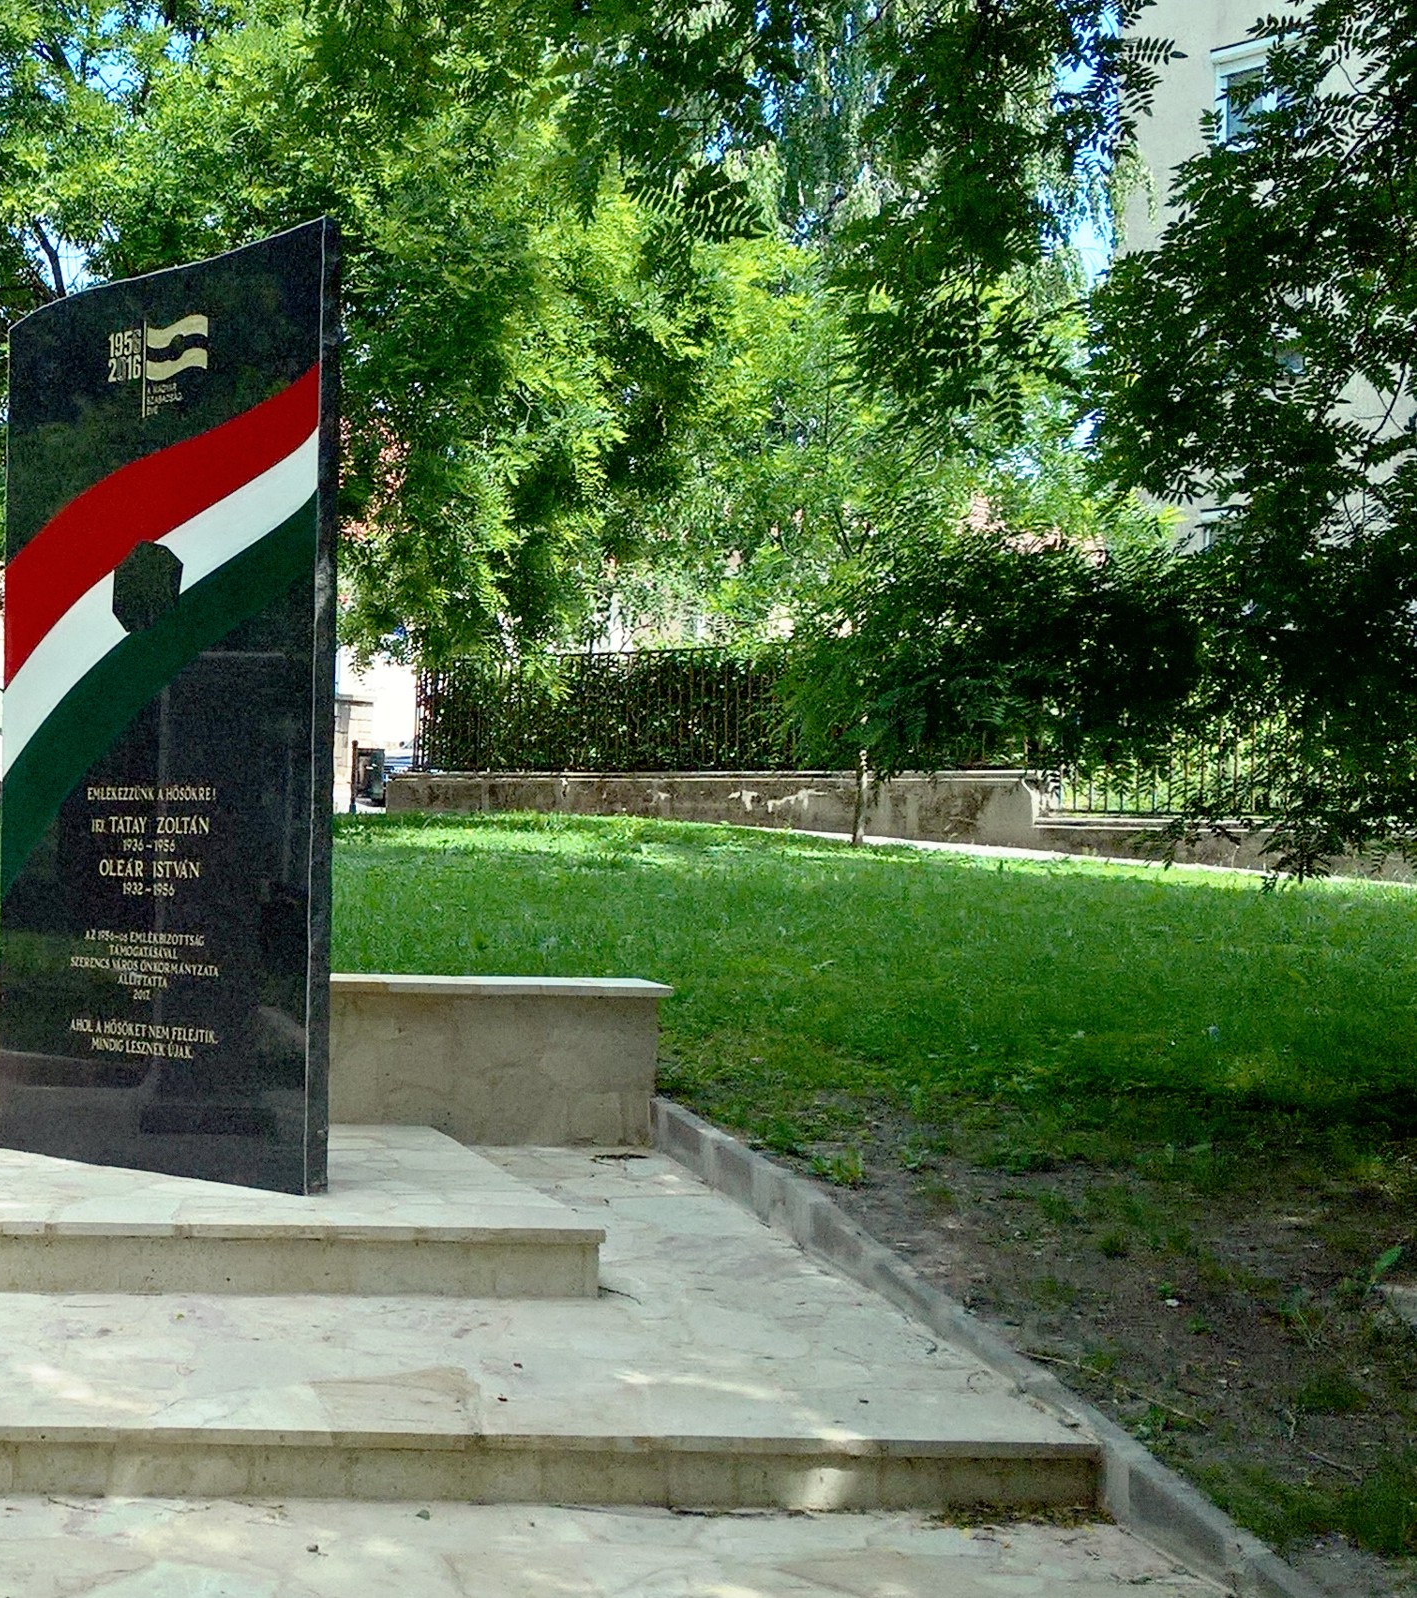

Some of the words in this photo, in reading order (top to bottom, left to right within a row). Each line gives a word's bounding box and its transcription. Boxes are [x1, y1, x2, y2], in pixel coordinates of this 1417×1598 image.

[108, 329, 142, 358] 1956
[108, 355, 142, 383] 2016
[87, 785, 155, 801] EMLÉKEZZÜNK
[157, 788, 164, 800] A
[108, 815, 148, 834] TATAY
[156, 815, 210, 835] ZOLTÁN
[99, 858, 144, 878] OLEÁR
[152, 859, 201, 879] ISTVÁN
[84, 928, 96, 940] AZ
[130, 930, 205, 946] EMLÉKBIZOTTSÁG
[70, 956, 111, 969] SZERENCS
[112, 957, 139, 972] VÁROS
[70, 1018, 93, 1032] AHOL
[95, 1020, 102, 1034] A
[148, 1023, 170, 1040] NEM
[91, 1036, 124, 1052] MINDIG
[125, 1040, 166, 1057] LESZNEK
